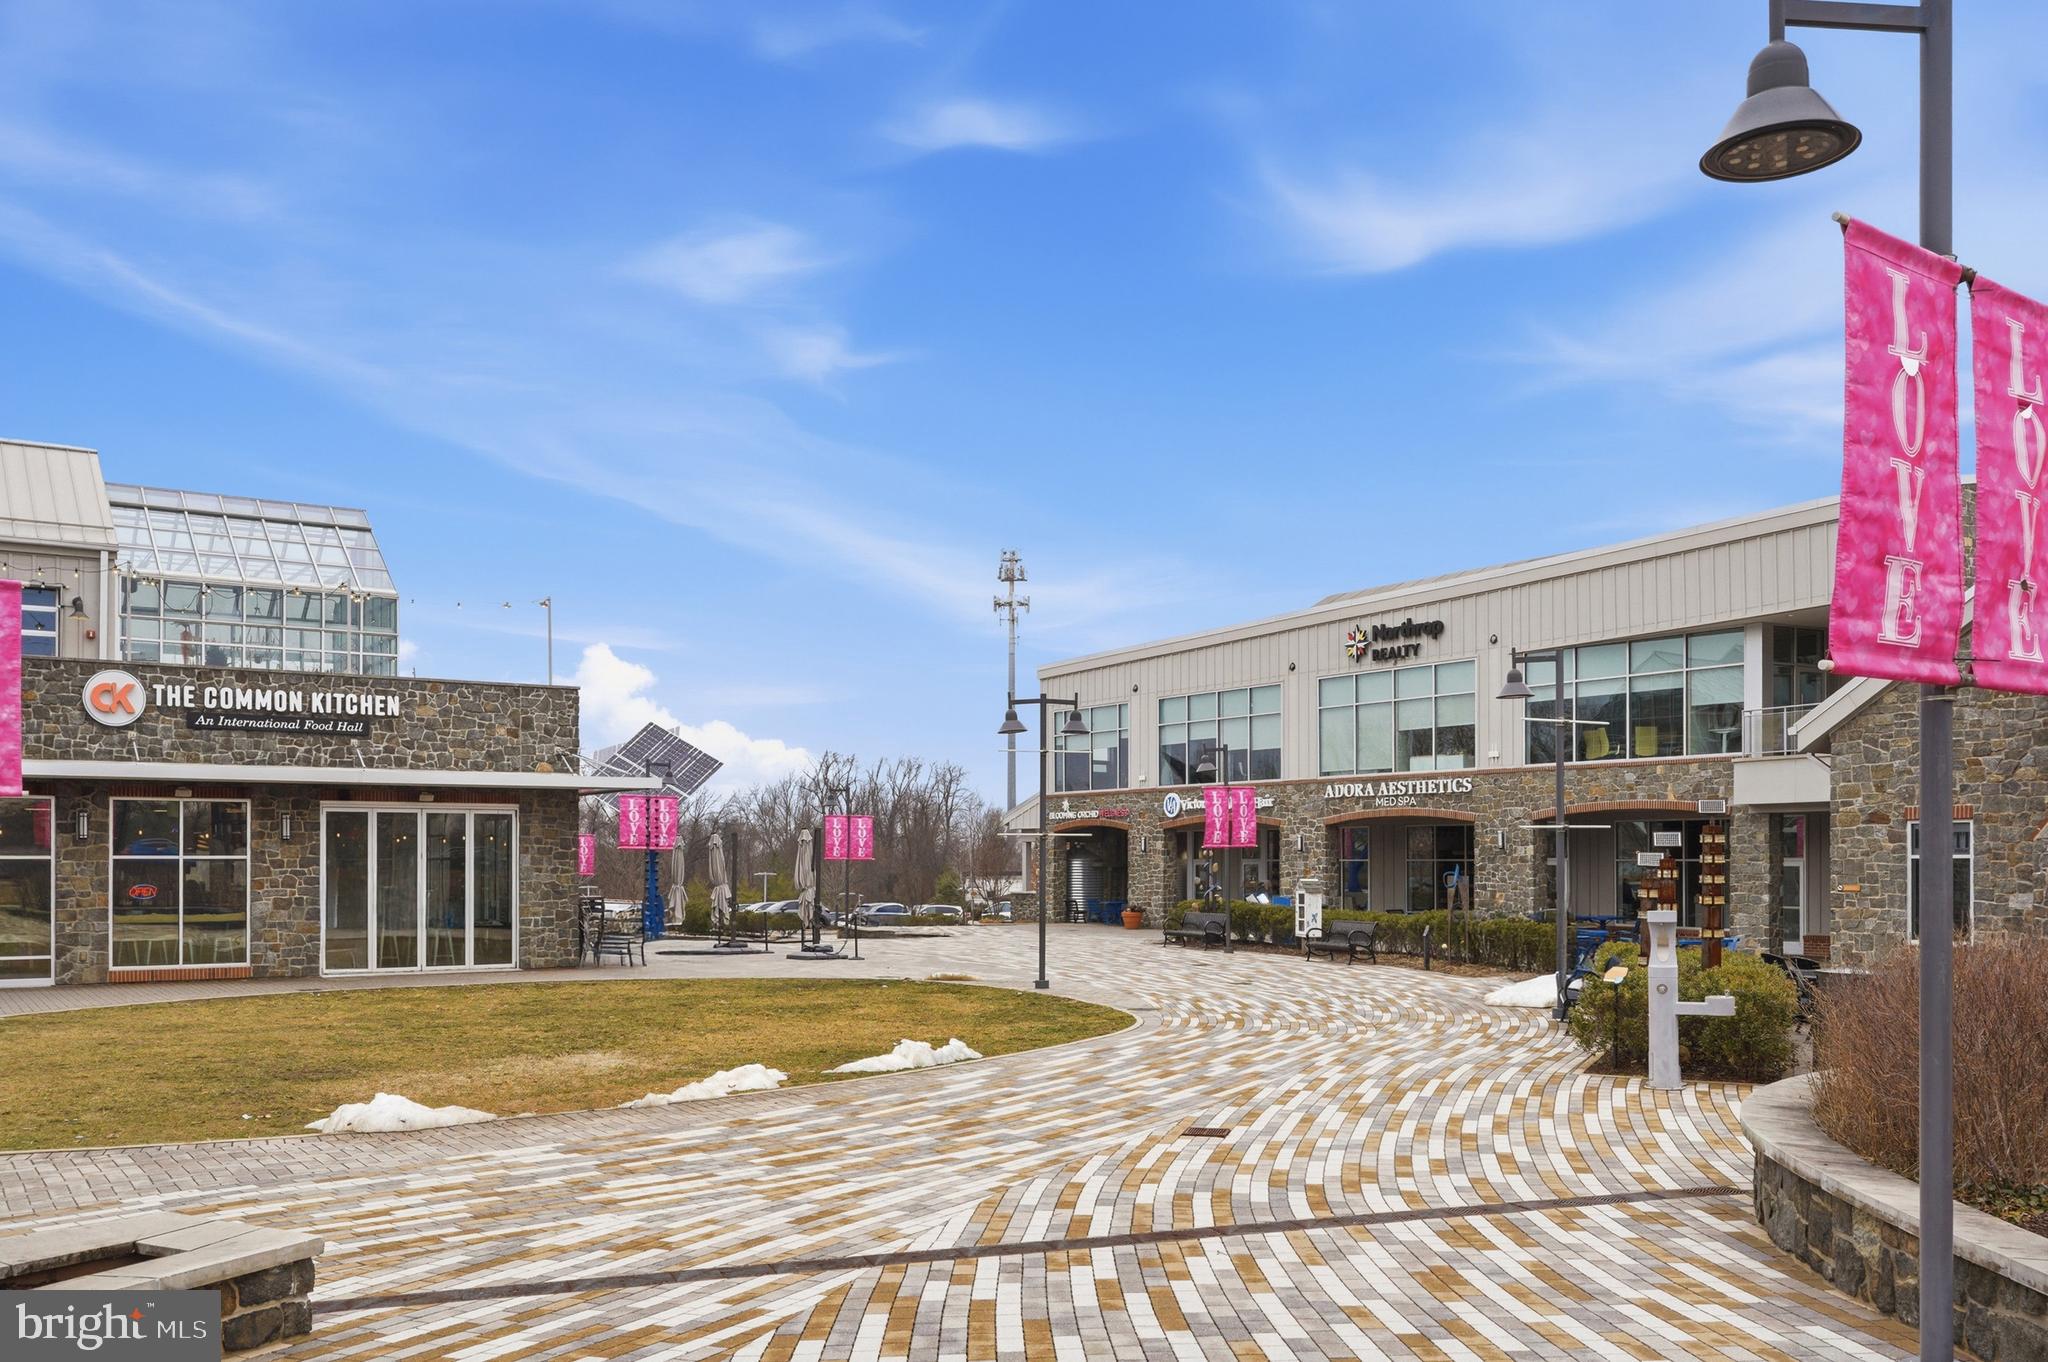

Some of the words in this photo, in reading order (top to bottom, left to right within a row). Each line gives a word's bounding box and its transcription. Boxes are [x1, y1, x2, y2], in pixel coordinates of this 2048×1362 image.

[1876, 267, 1929, 648] LOVE
[2005, 316, 2045, 663] LOVE
[1372, 618, 1444, 641] Northrop
[1372, 643, 1420, 661] REALTY
[90, 682, 136, 714] CK
[153, 683, 196, 708] THE
[204, 686, 303, 712] COMMON
[311, 691, 400, 716] KITCHEN
[195, 715, 215, 727] An
[217, 715, 301, 729] International
[304, 719, 334, 732] Food
[336, 720, 364, 733] Hall
[1324, 783, 1375, 798] ADORA
[1378, 777, 1473, 797] AESTHETICS
[1375, 797, 1397, 807] MED
[1397, 796, 1417, 807] SPA
[629, 798, 640, 846] LOVE
[659, 799, 670, 847] LOVE
[1049, 811, 1077, 820] BLOOMING
[1077, 809, 1099, 819] ORCHID
[1212, 790, 1223, 844] LOVE
[1238, 790, 1249, 844] LOVE
[833, 818, 842, 857] LOVE
[857, 818, 867, 857] LOVE
[130, 885, 158, 898] OPEN
